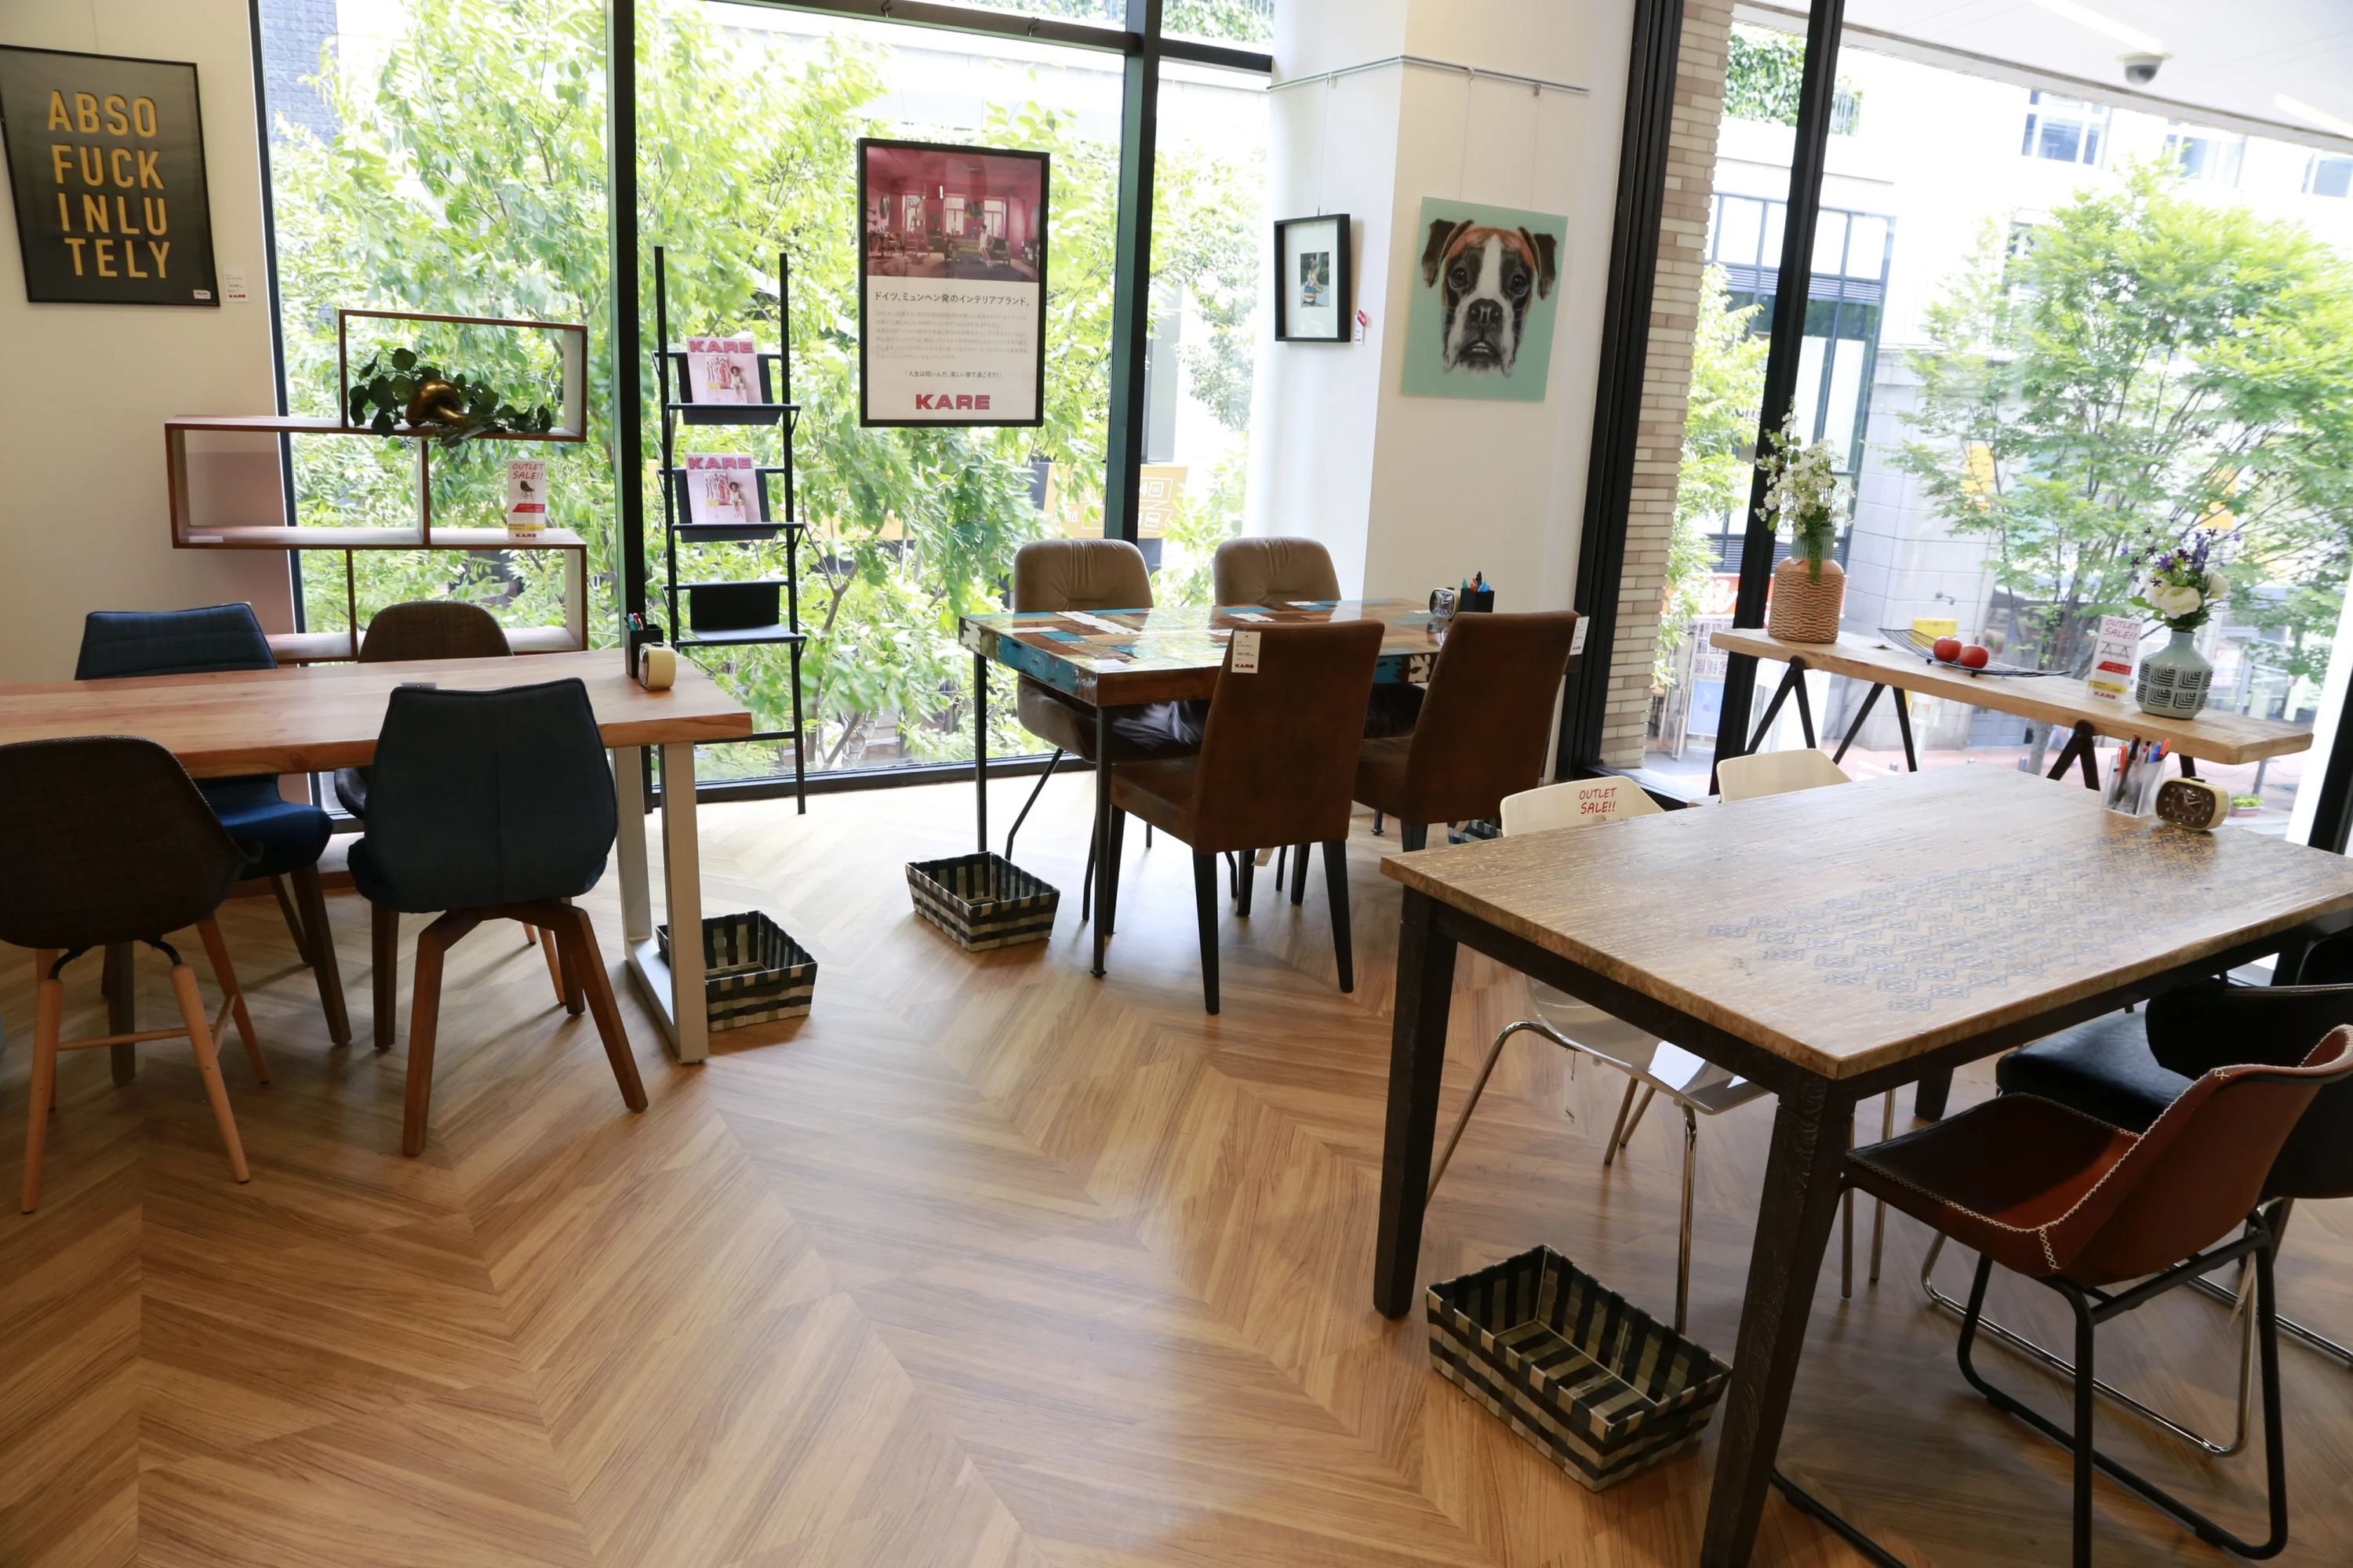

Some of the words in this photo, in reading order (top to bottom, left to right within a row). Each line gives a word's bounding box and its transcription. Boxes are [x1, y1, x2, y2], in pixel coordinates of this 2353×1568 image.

[48, 89, 158, 138] ABSO
[52, 144, 165, 190] FUCK
[58, 192, 168, 236] INLU
[64, 238, 170, 278] TELY
[689, 340, 754, 354] KARE
[915, 394, 991, 410] KARE
[688, 457, 751, 469] KARE
[512, 471, 544, 480] SALE!!
[2105, 619, 2140, 630] OUTLET
[2104, 628, 2137, 640] SALE!!
[1579, 787, 1617, 800] OUTLET
[1580, 801, 1617, 814] SALE!!
